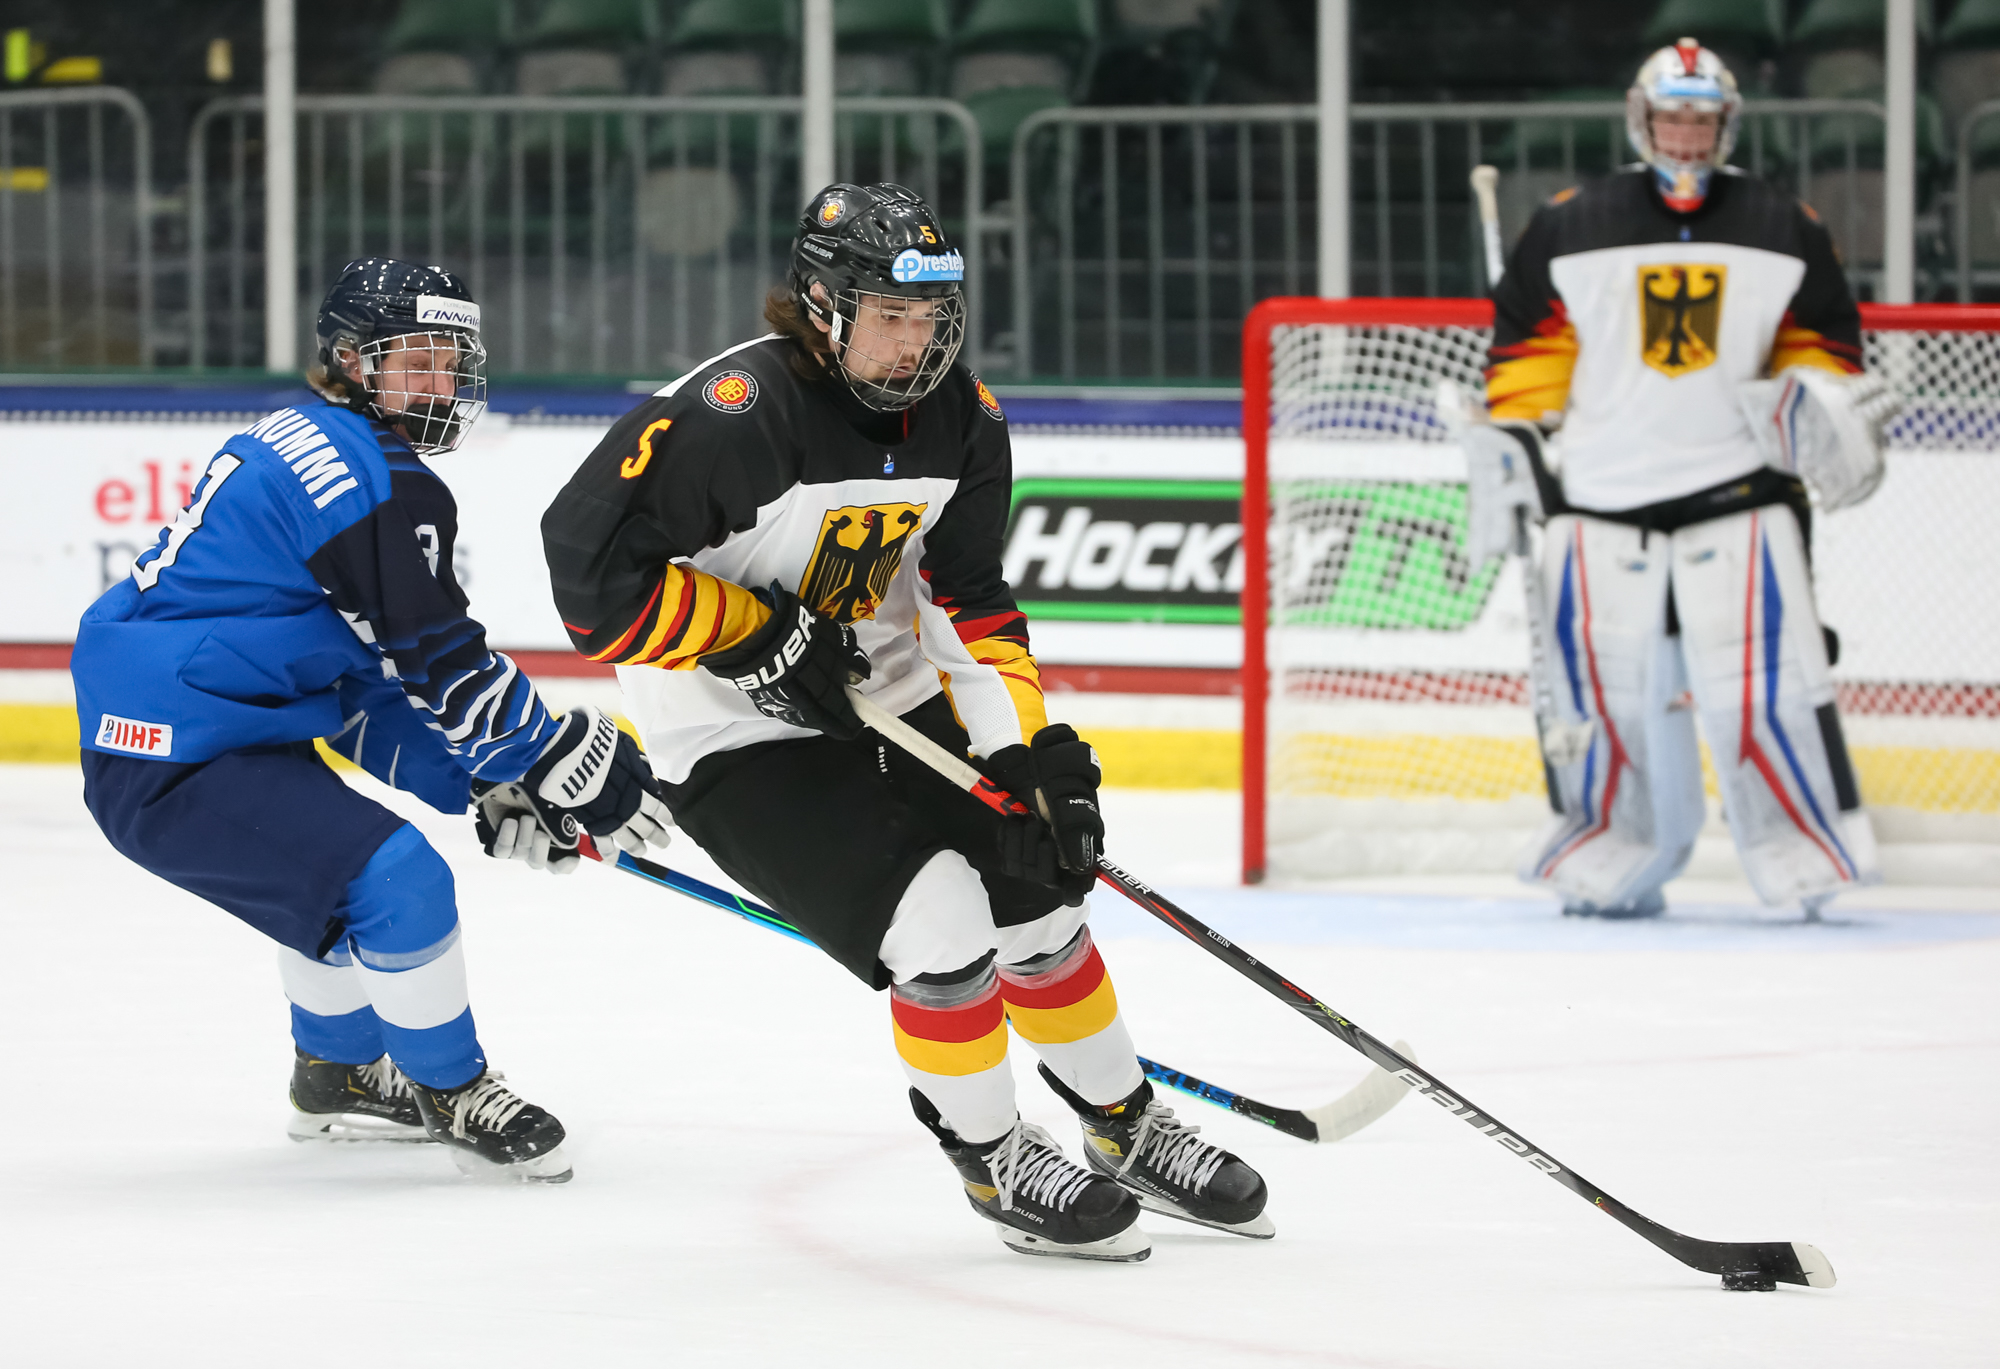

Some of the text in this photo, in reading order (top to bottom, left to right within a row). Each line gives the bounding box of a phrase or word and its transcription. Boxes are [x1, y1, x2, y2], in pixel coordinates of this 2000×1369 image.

[919, 225, 937, 244] 5
[801, 292, 823, 316] BAUER
[236, 407, 359, 510] NUMMI
[620, 418, 673, 480] 5
[114, 722, 162, 750] IIHF
[1206, 929, 1231, 949] KLEIN
[1136, 1175, 1180, 1203] BAUER
[1012, 1206, 1045, 1226] AUER
